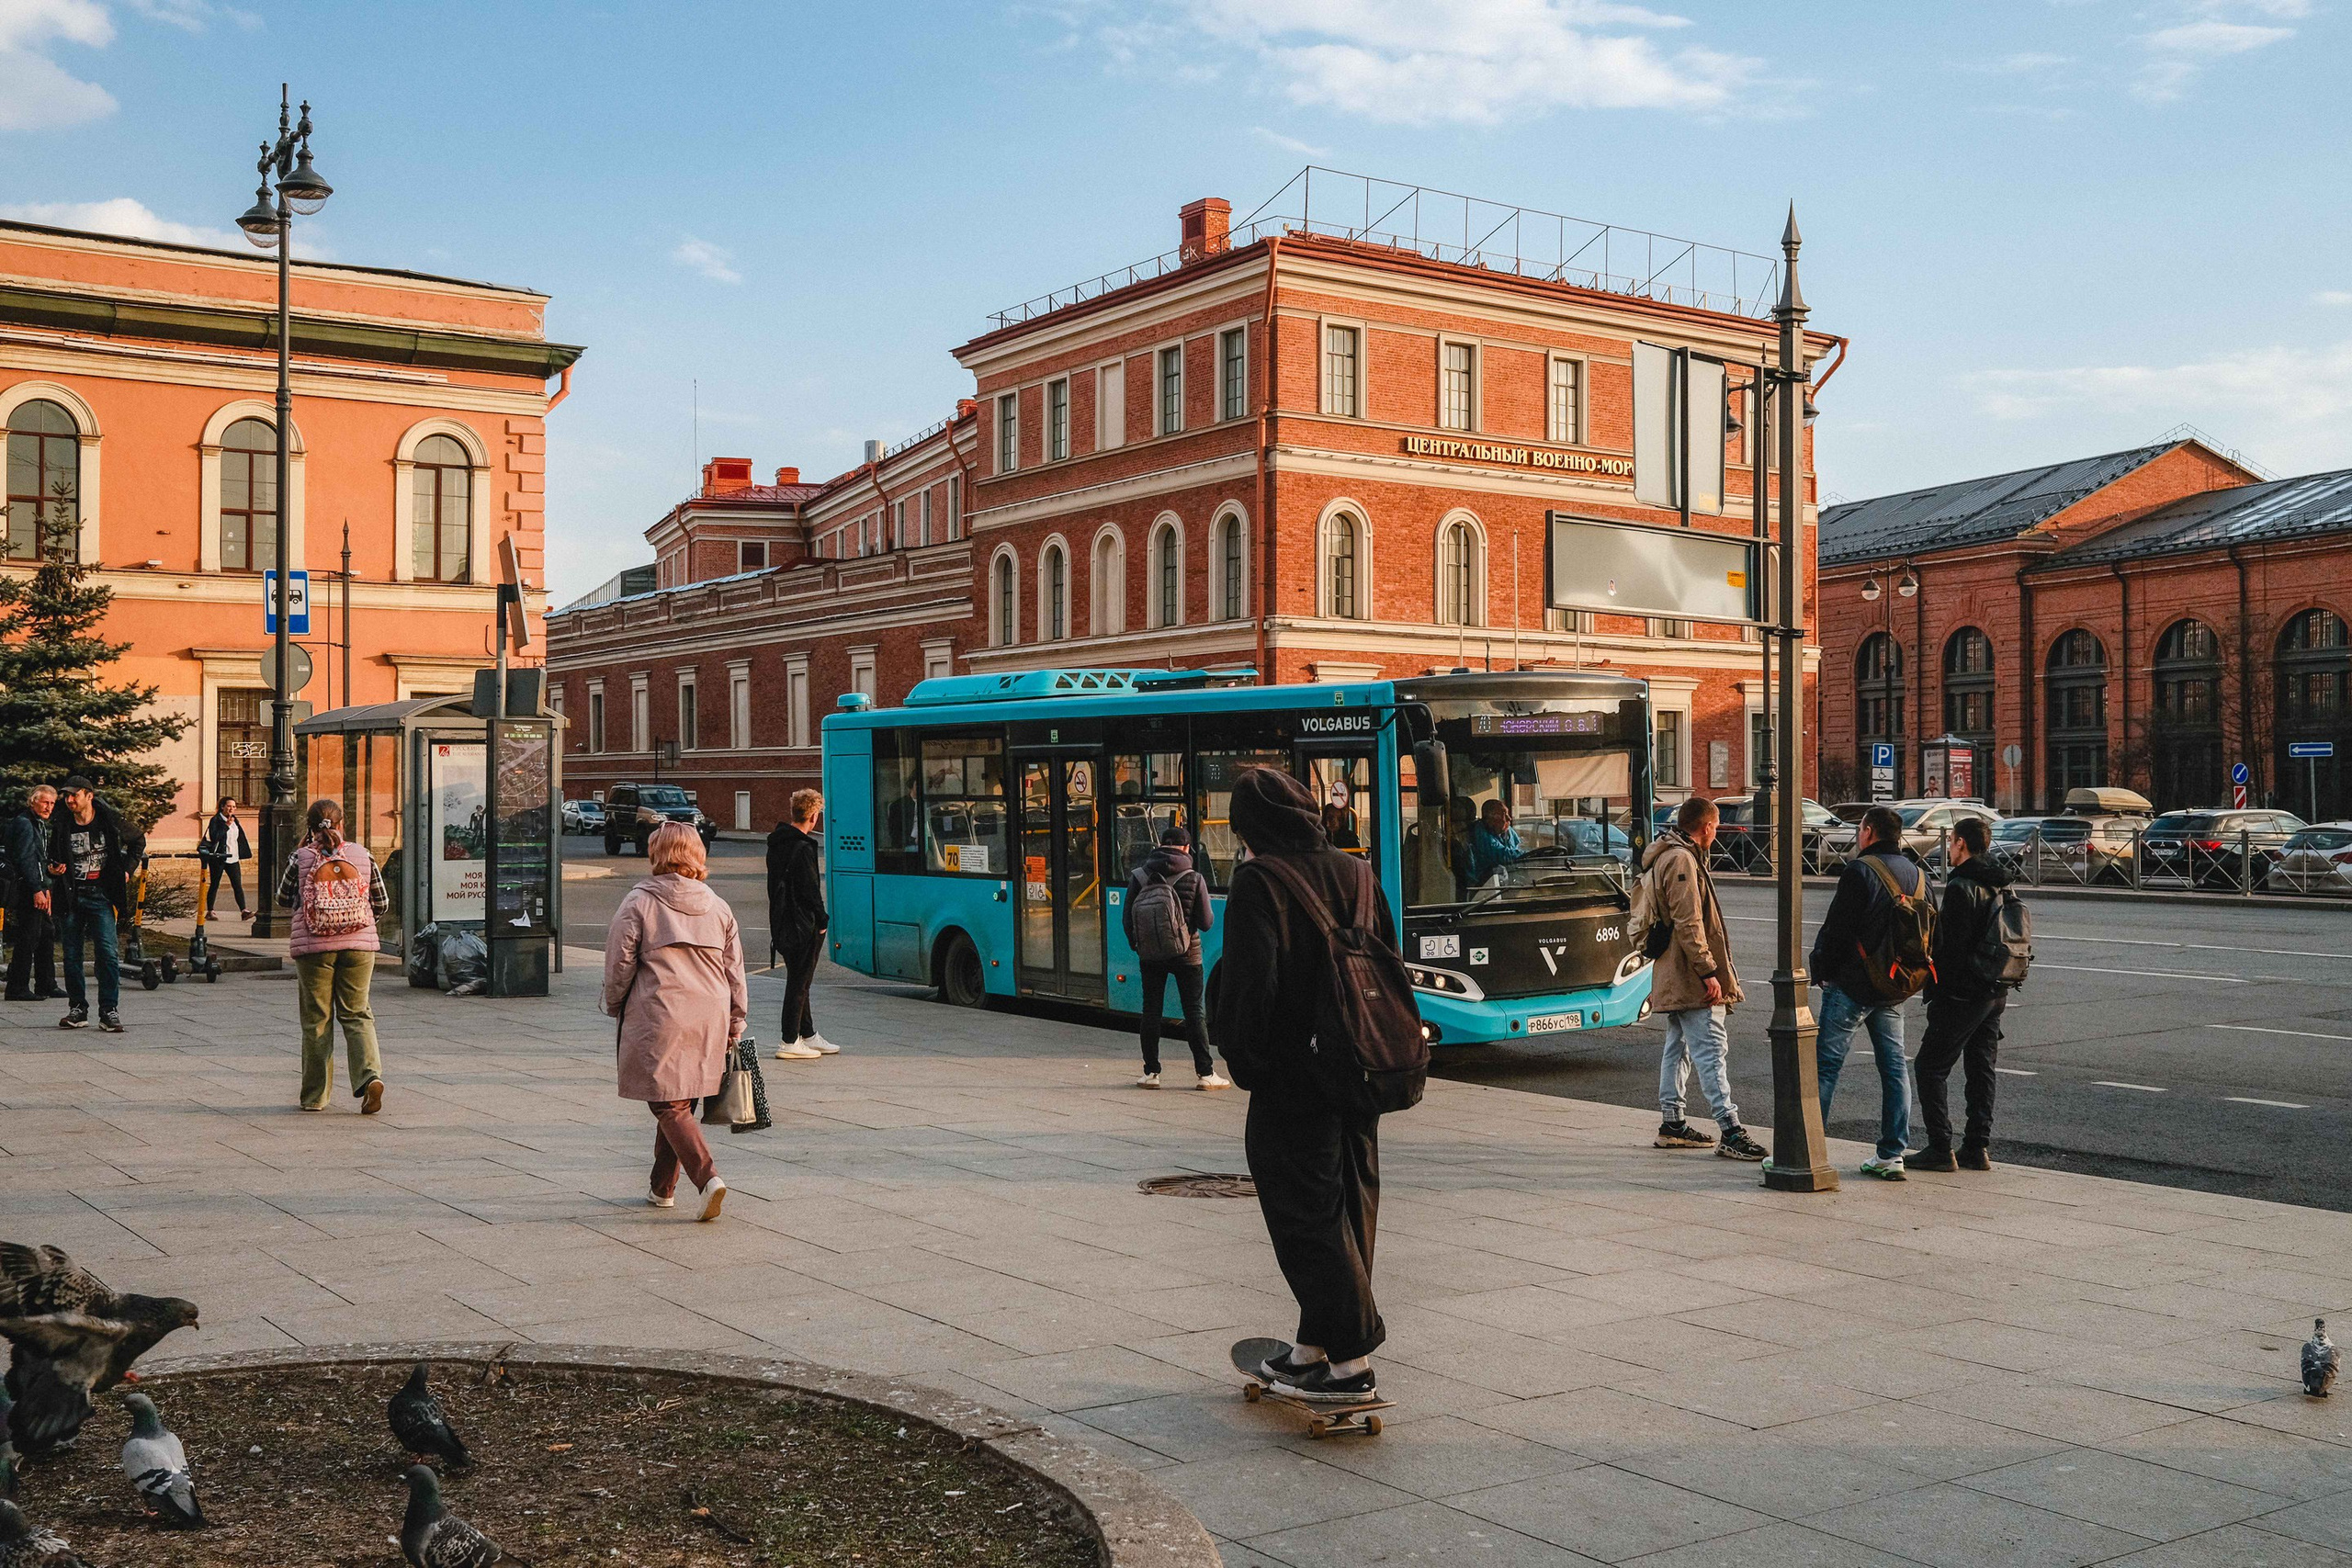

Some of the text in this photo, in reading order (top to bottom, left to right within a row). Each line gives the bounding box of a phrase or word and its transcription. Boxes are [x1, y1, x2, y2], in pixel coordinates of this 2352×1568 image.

[1407, 436, 1634, 476] ЦЕНТРАЛЬНЫЙ ВОЕННО-МОР
[1301, 716, 1371, 732] VOLGABUS
[1878, 746, 1890, 764] P
[947, 852, 958, 866] 70
[447, 891, 466, 899] МОЙ
[1596, 926, 1620, 942] 6896
[1566, 1014, 1579, 1024] 198
